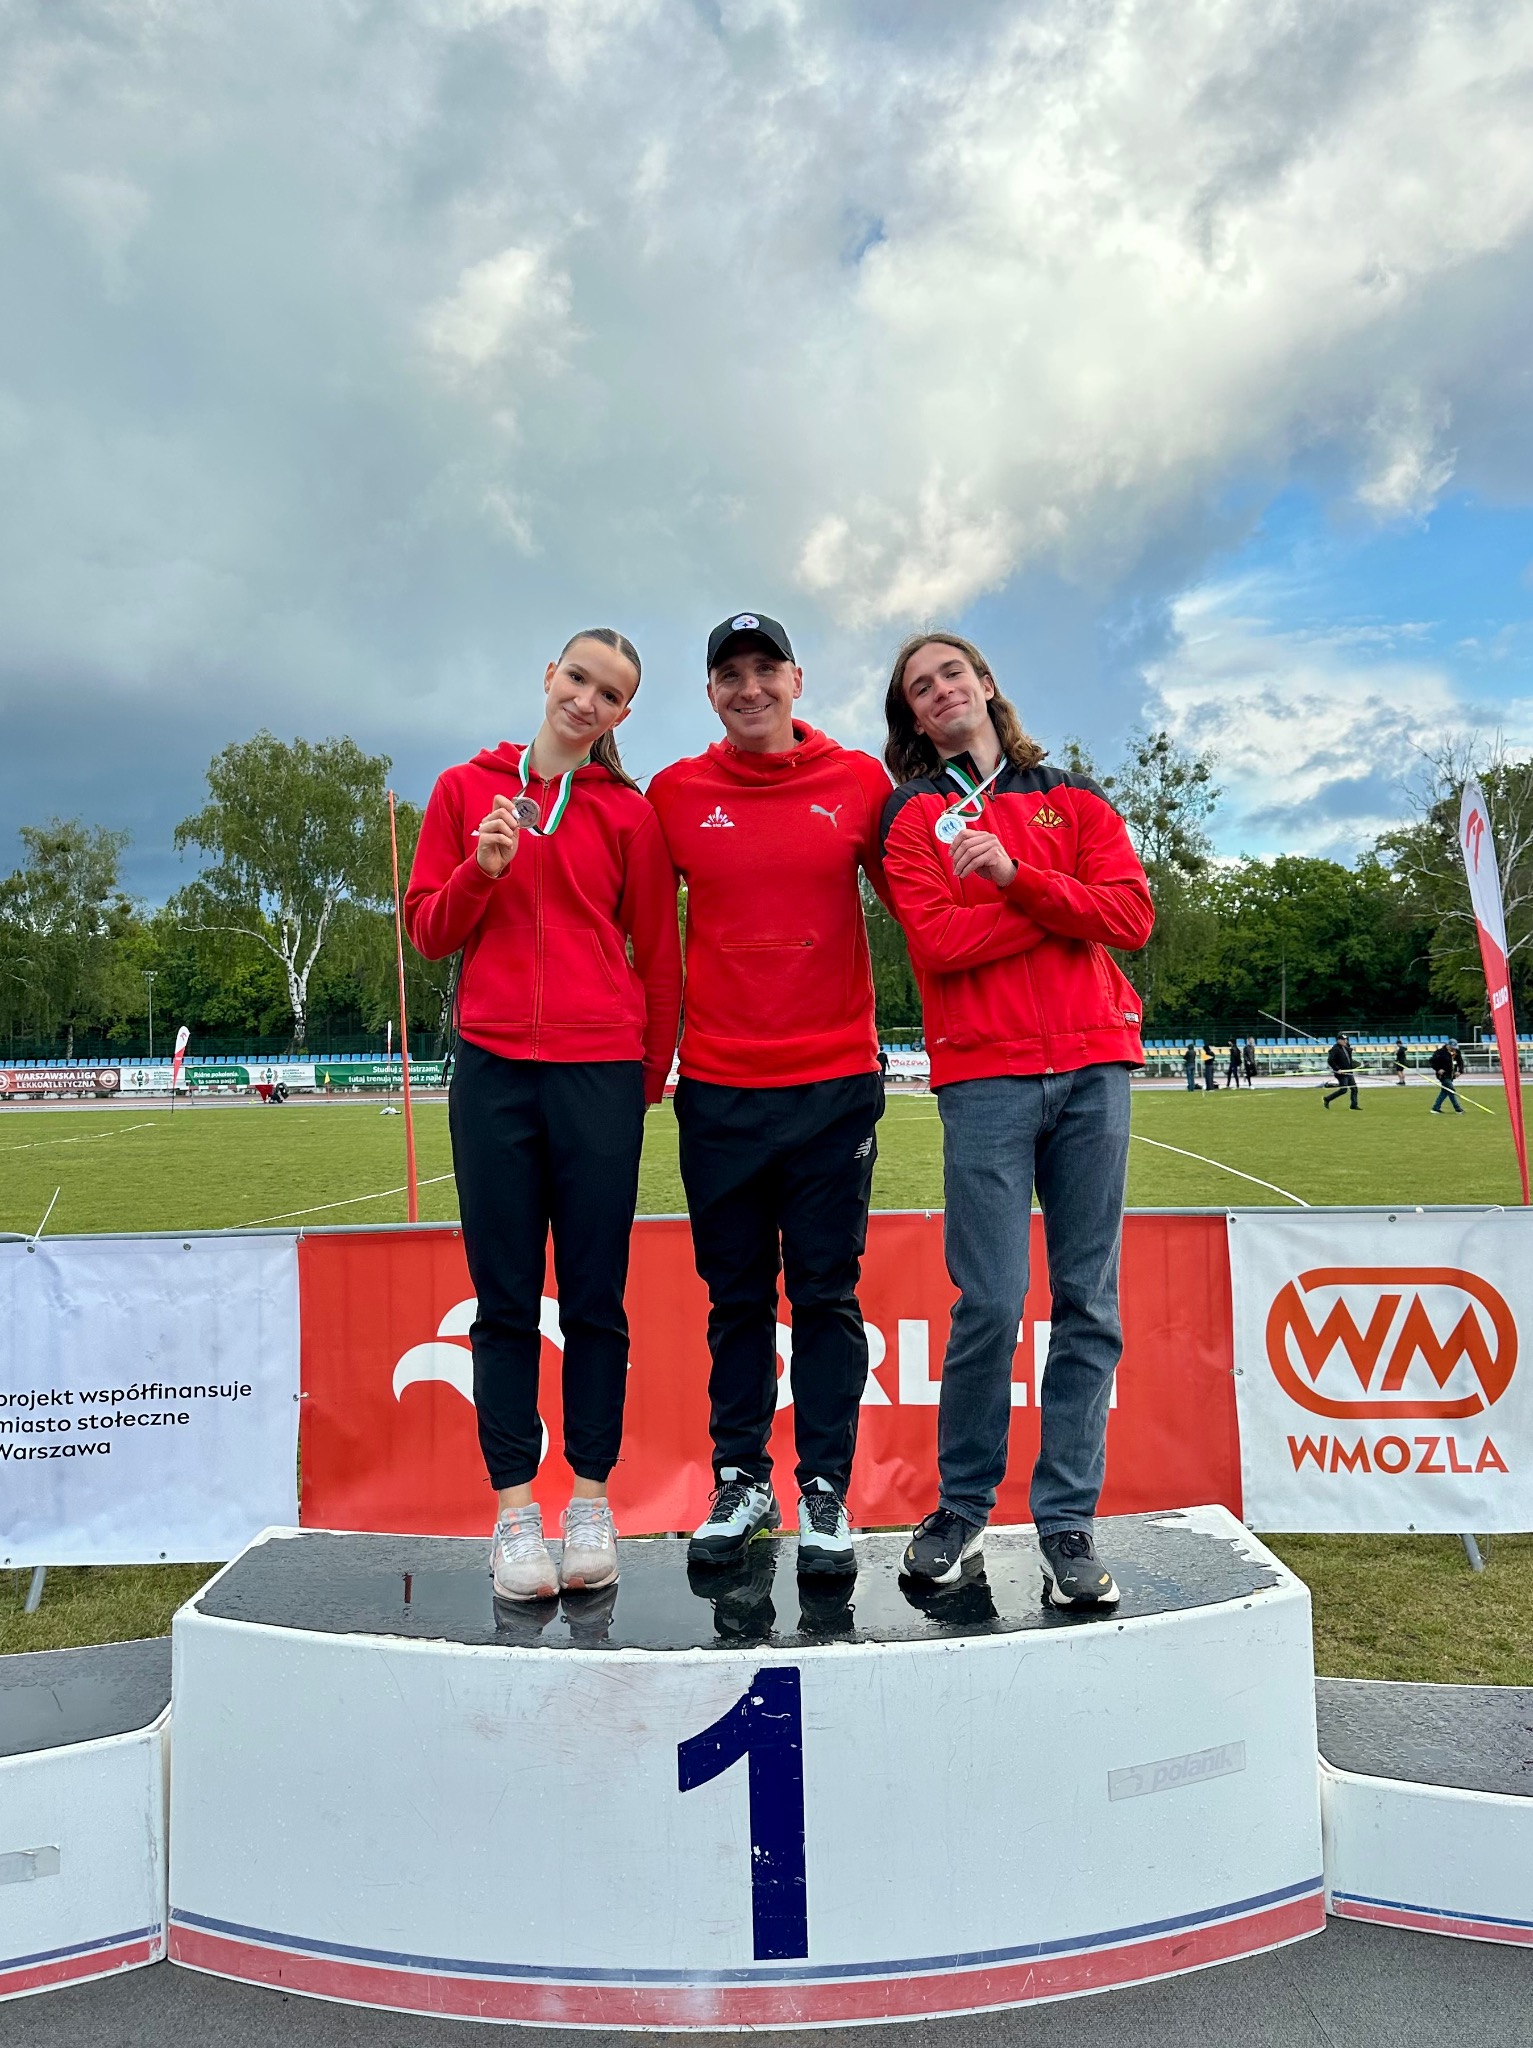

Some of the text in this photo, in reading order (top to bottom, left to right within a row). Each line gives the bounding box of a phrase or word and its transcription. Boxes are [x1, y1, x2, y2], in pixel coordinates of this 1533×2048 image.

[15, 1072, 74, 1080] WARSZAWSKA
[348, 1076, 365, 1084] tutaj
[407, 1065, 440, 1073] istrzami,
[16, 1080, 96, 1089] LEKKOATLETYCZNA
[1276, 1279, 1508, 1406] WM
[79, 1381, 252, 1406] współfinansuje
[0, 1411, 190, 1433] miasto stołeczne
[1286, 1435, 1510, 1474] WMOZLA
[1151, 1750, 1233, 1791] polanik
[677, 1666, 809, 1961] 1
